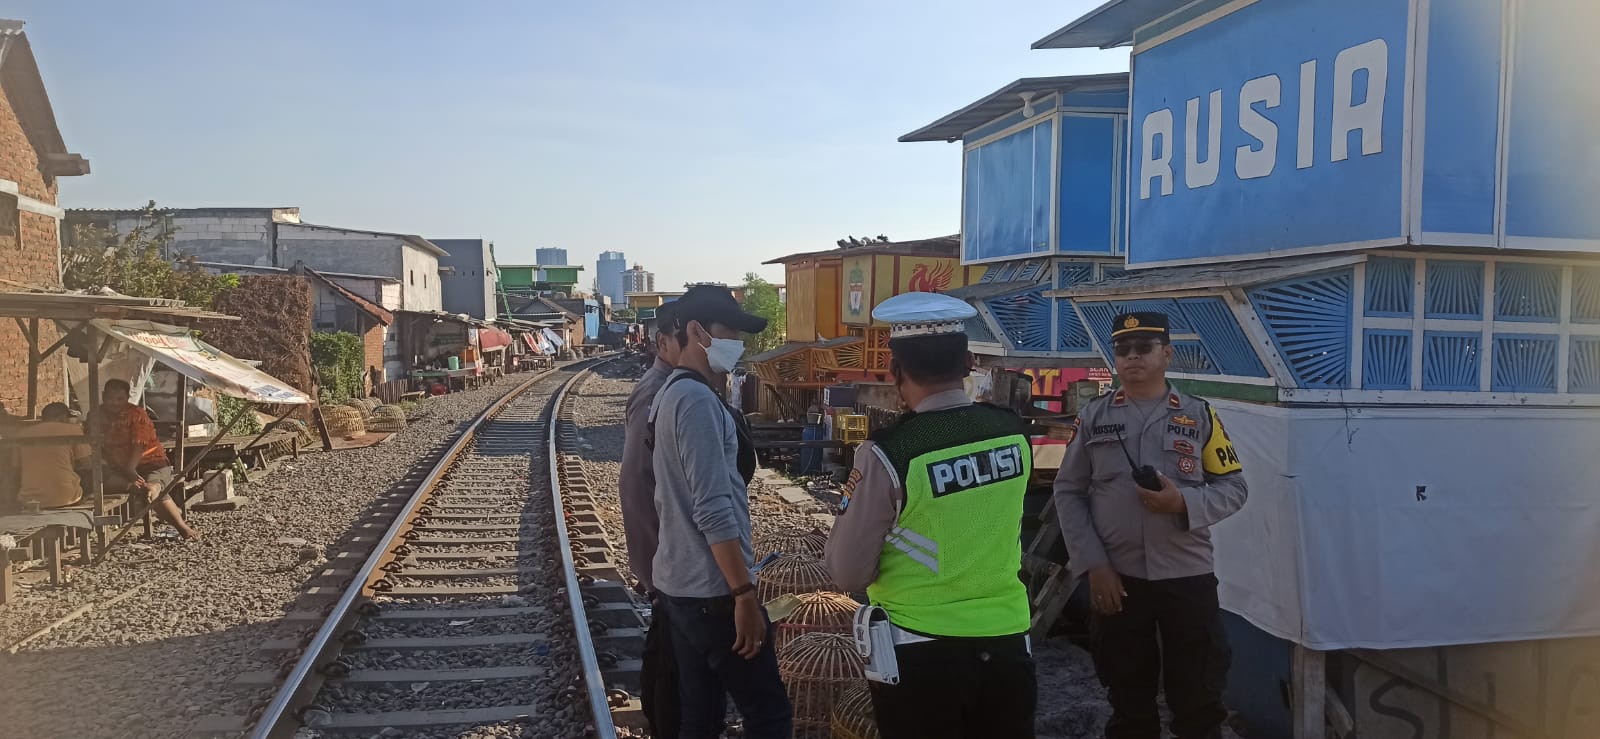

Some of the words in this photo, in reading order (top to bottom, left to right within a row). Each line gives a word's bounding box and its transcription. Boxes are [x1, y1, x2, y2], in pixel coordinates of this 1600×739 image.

[1140, 38, 1388, 201] RUSIA
[1167, 424, 1200, 440] POLRI
[932, 446, 1021, 494] POLISI
[1215, 445, 1241, 467] PA
